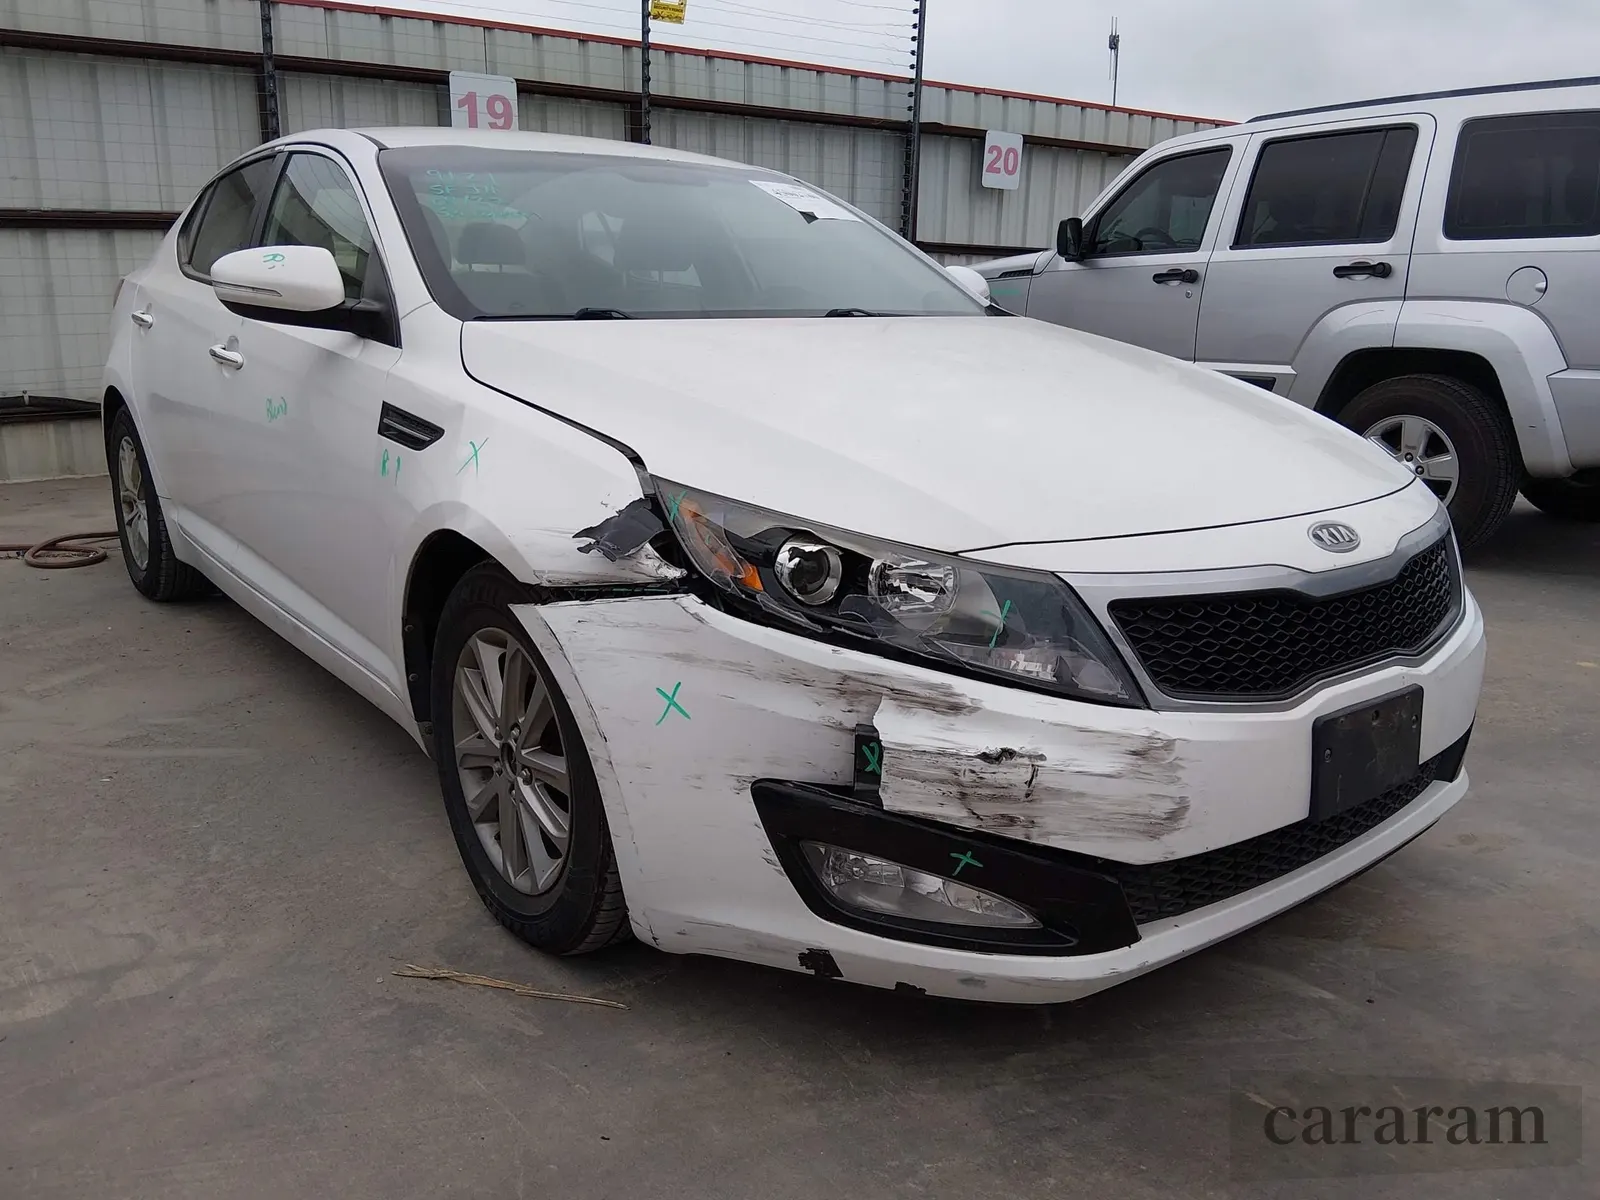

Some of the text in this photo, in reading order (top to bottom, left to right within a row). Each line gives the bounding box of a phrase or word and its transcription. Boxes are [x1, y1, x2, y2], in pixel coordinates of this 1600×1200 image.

[457, 91, 514, 131] 19
[986, 145, 1019, 176] 20
[1316, 525, 1356, 546] KIA
